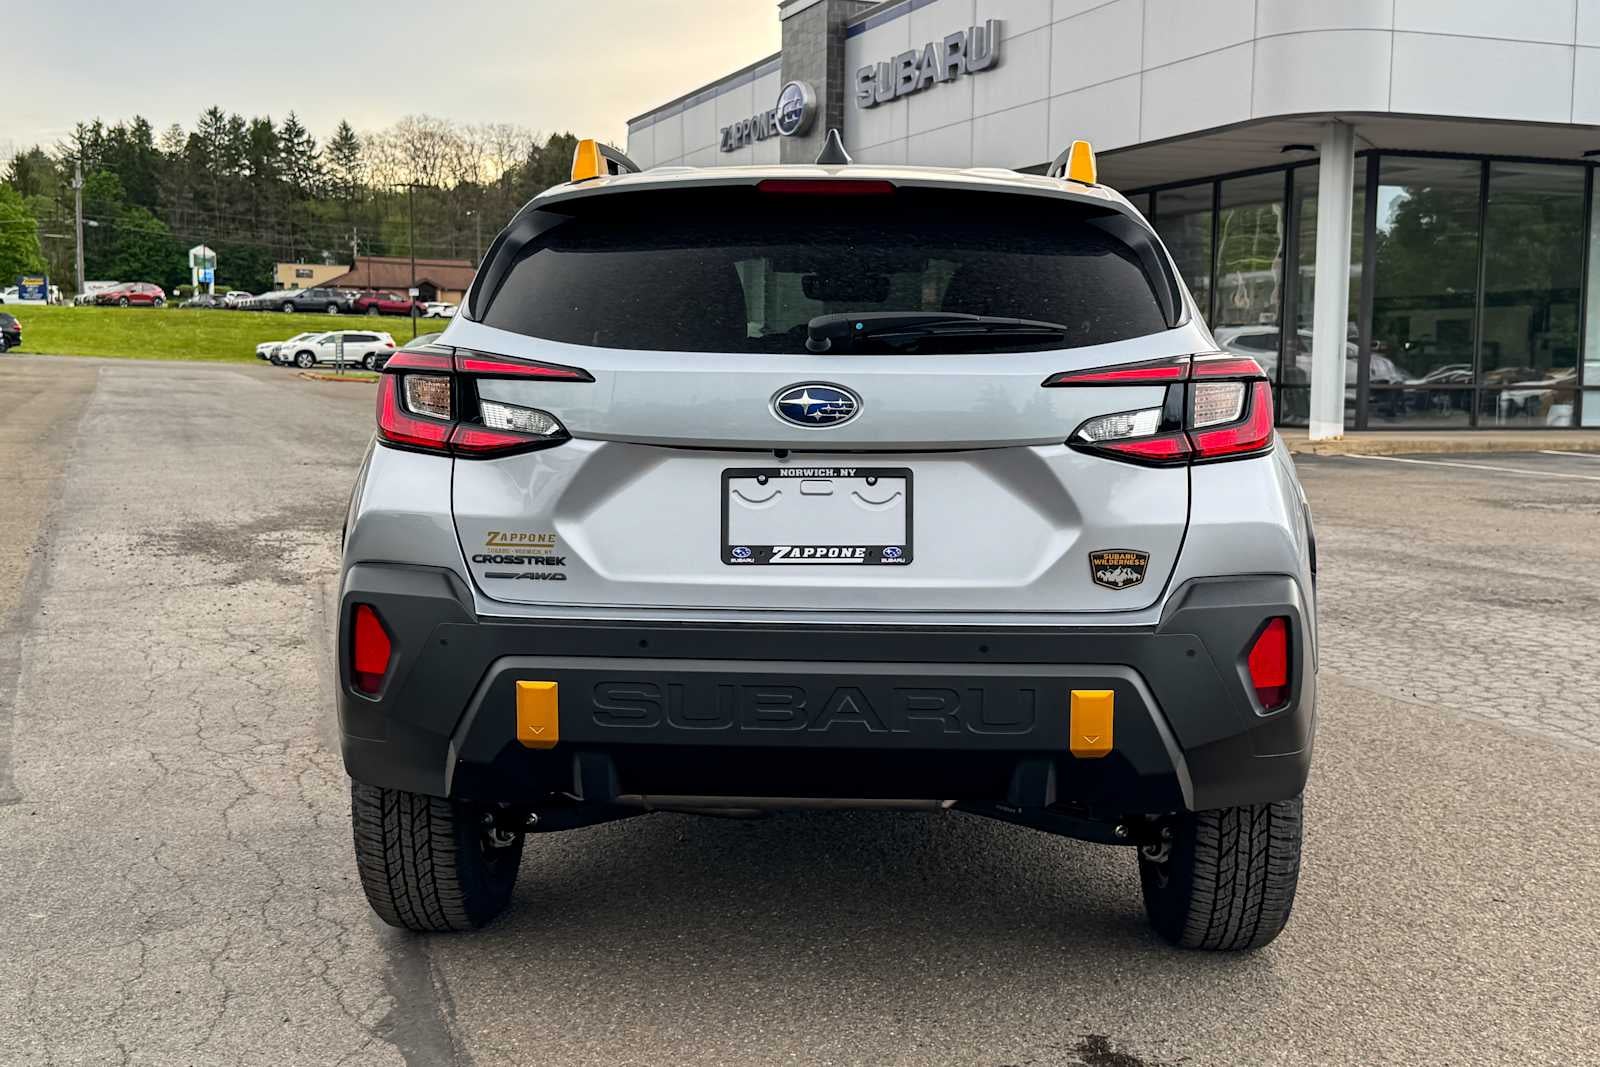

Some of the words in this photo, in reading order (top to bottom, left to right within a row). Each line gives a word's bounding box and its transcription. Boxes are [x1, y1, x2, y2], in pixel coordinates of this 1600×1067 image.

[856, 19, 1003, 109] SUBARU
[720, 109, 780, 152] ZAPPONE
[840, 469, 857, 477] NY
[485, 531, 556, 546] ZAPPONE
[471, 554, 567, 566] CROSSTREK
[769, 546, 866, 563] ZAPPONE
[592, 681, 1037, 735] SUBARU
